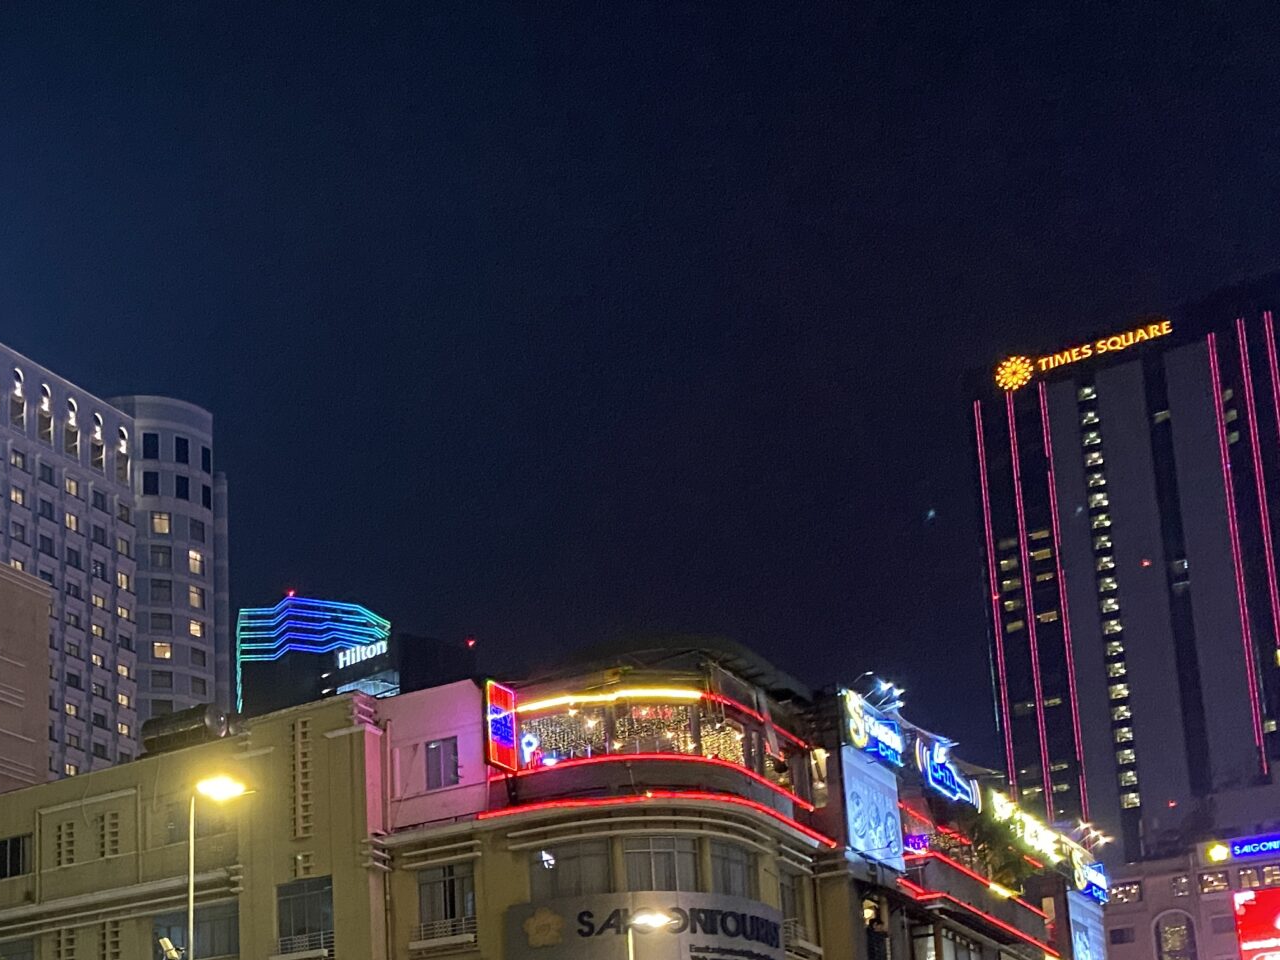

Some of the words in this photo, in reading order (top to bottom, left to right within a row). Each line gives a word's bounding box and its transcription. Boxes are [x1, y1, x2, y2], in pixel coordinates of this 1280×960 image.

[1038, 344, 1092, 371] TIMES
[1096, 320, 1173, 353] SQUARE
[338, 640, 387, 669] Hilton
